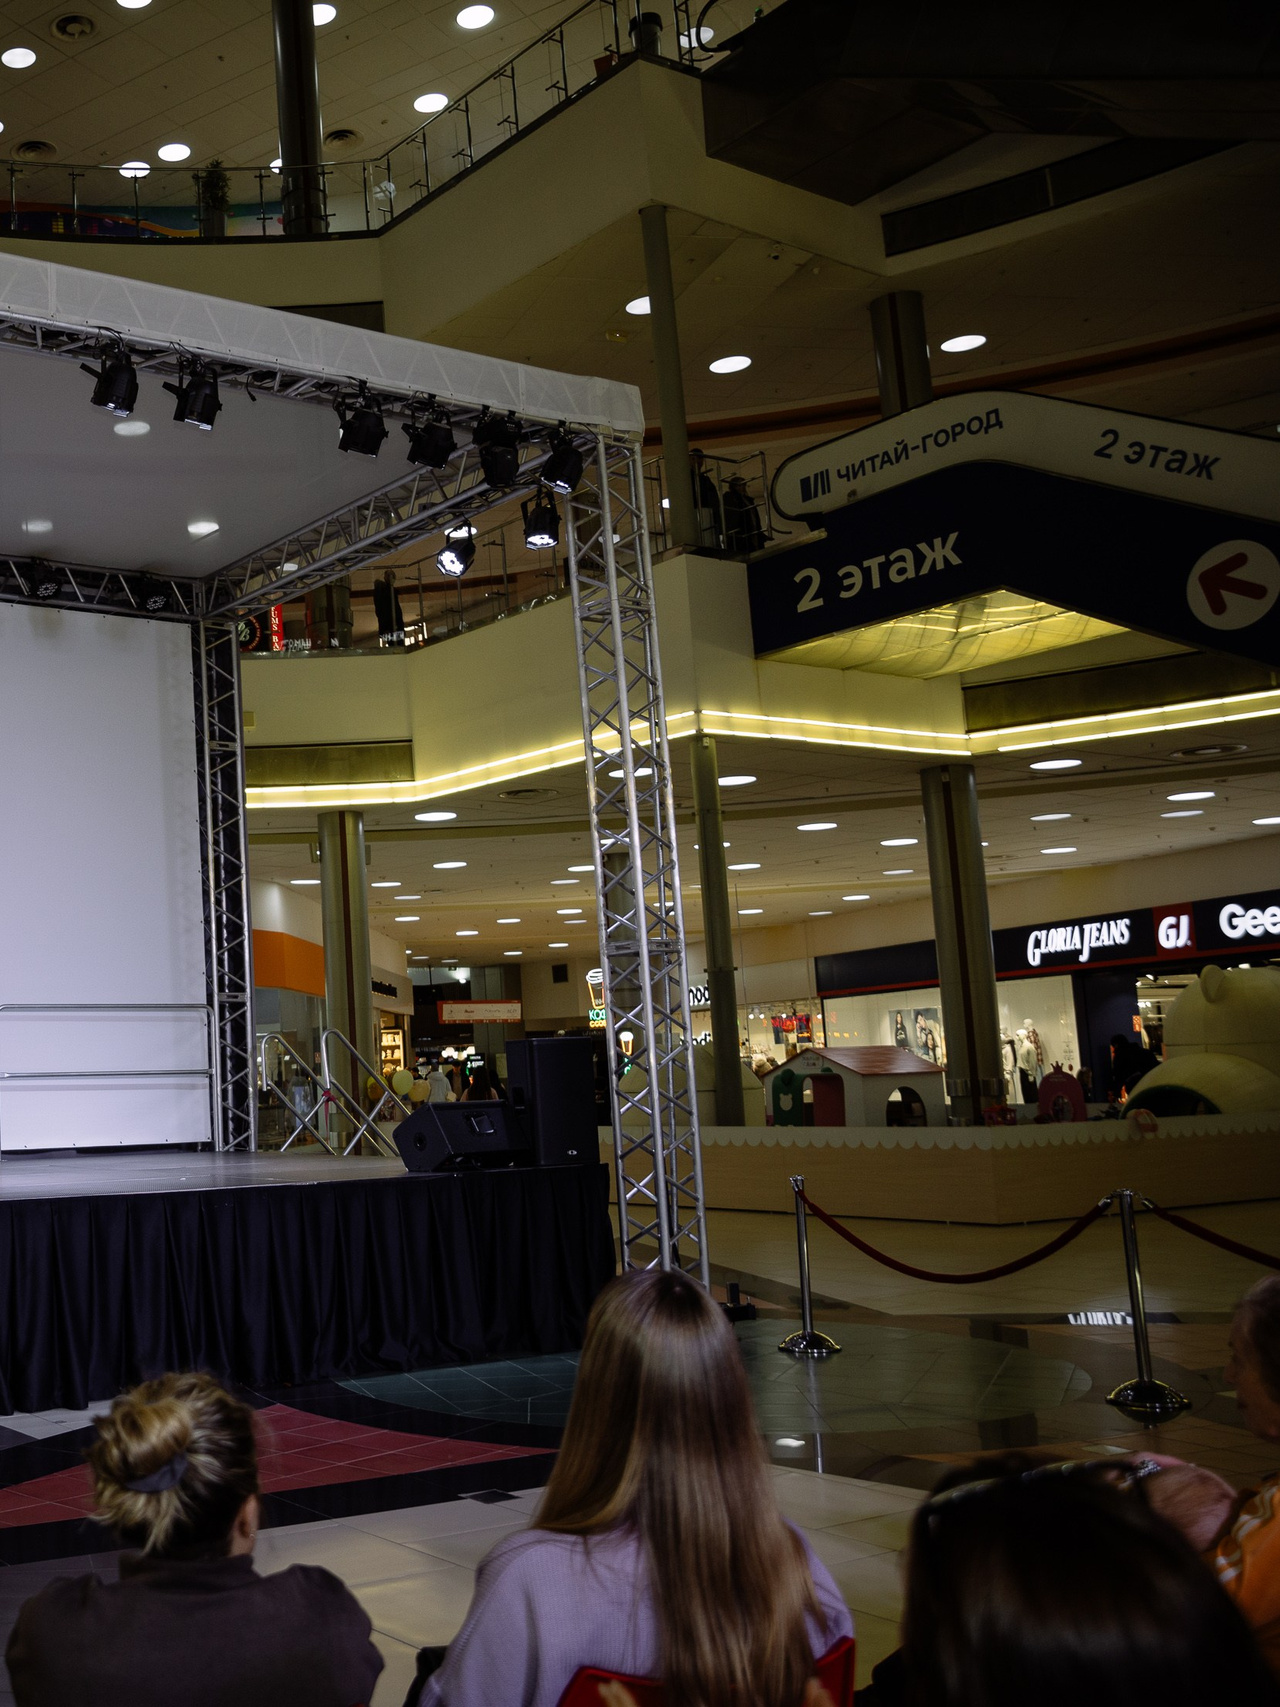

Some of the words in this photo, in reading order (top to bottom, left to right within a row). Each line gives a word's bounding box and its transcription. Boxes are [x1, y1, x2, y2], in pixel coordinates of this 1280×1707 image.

[836, 408, 1003, 483] ЧИТАЙ-ГОРОД
[1093, 428, 1121, 459] 2
[1123, 440, 1221, 480] этаж
[793, 567, 824, 613] 2
[838, 532, 963, 598] этаж
[1027, 925, 1081, 967] GLORIA
[1078, 918, 1131, 963] JEANS
